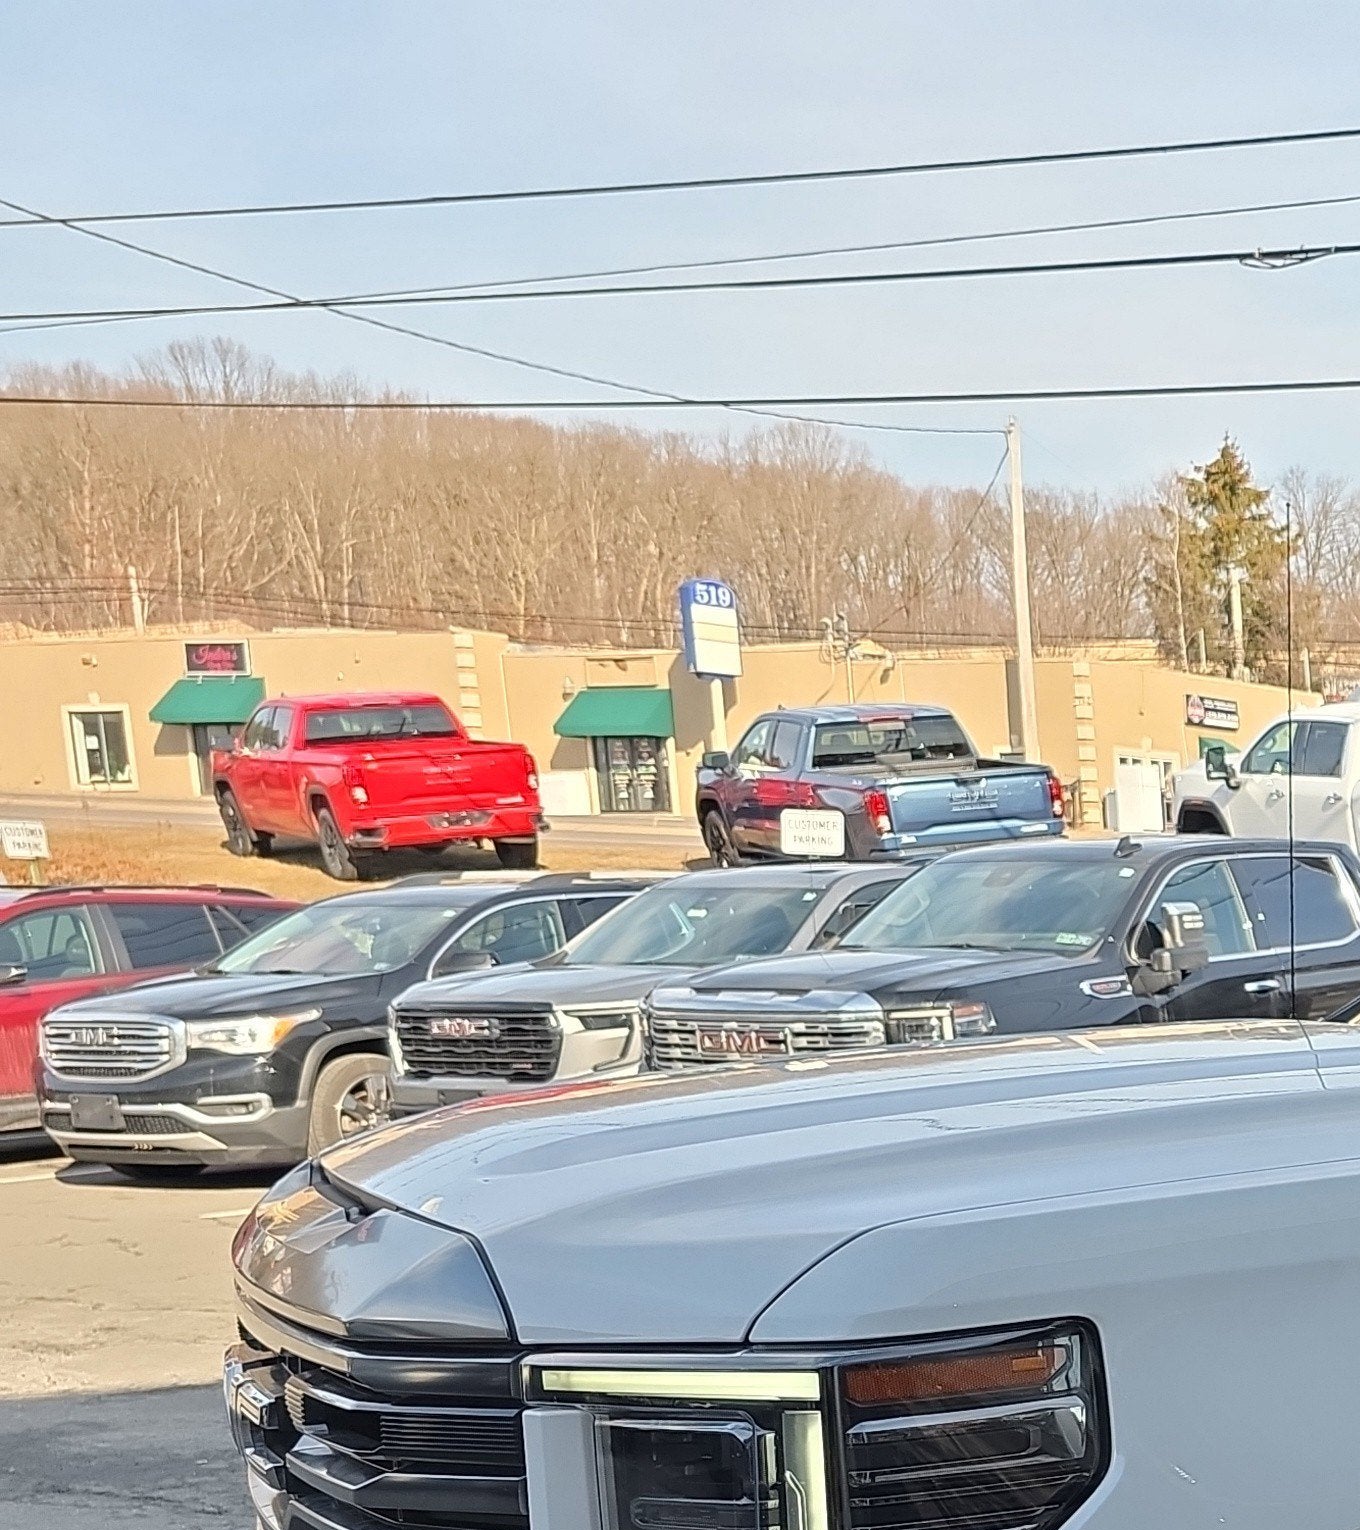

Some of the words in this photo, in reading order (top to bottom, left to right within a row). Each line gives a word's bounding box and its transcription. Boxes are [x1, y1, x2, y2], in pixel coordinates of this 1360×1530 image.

[694, 582, 732, 608] 519
[788, 819, 839, 831] CUSTOMER
[793, 835, 833, 846] PARKING
